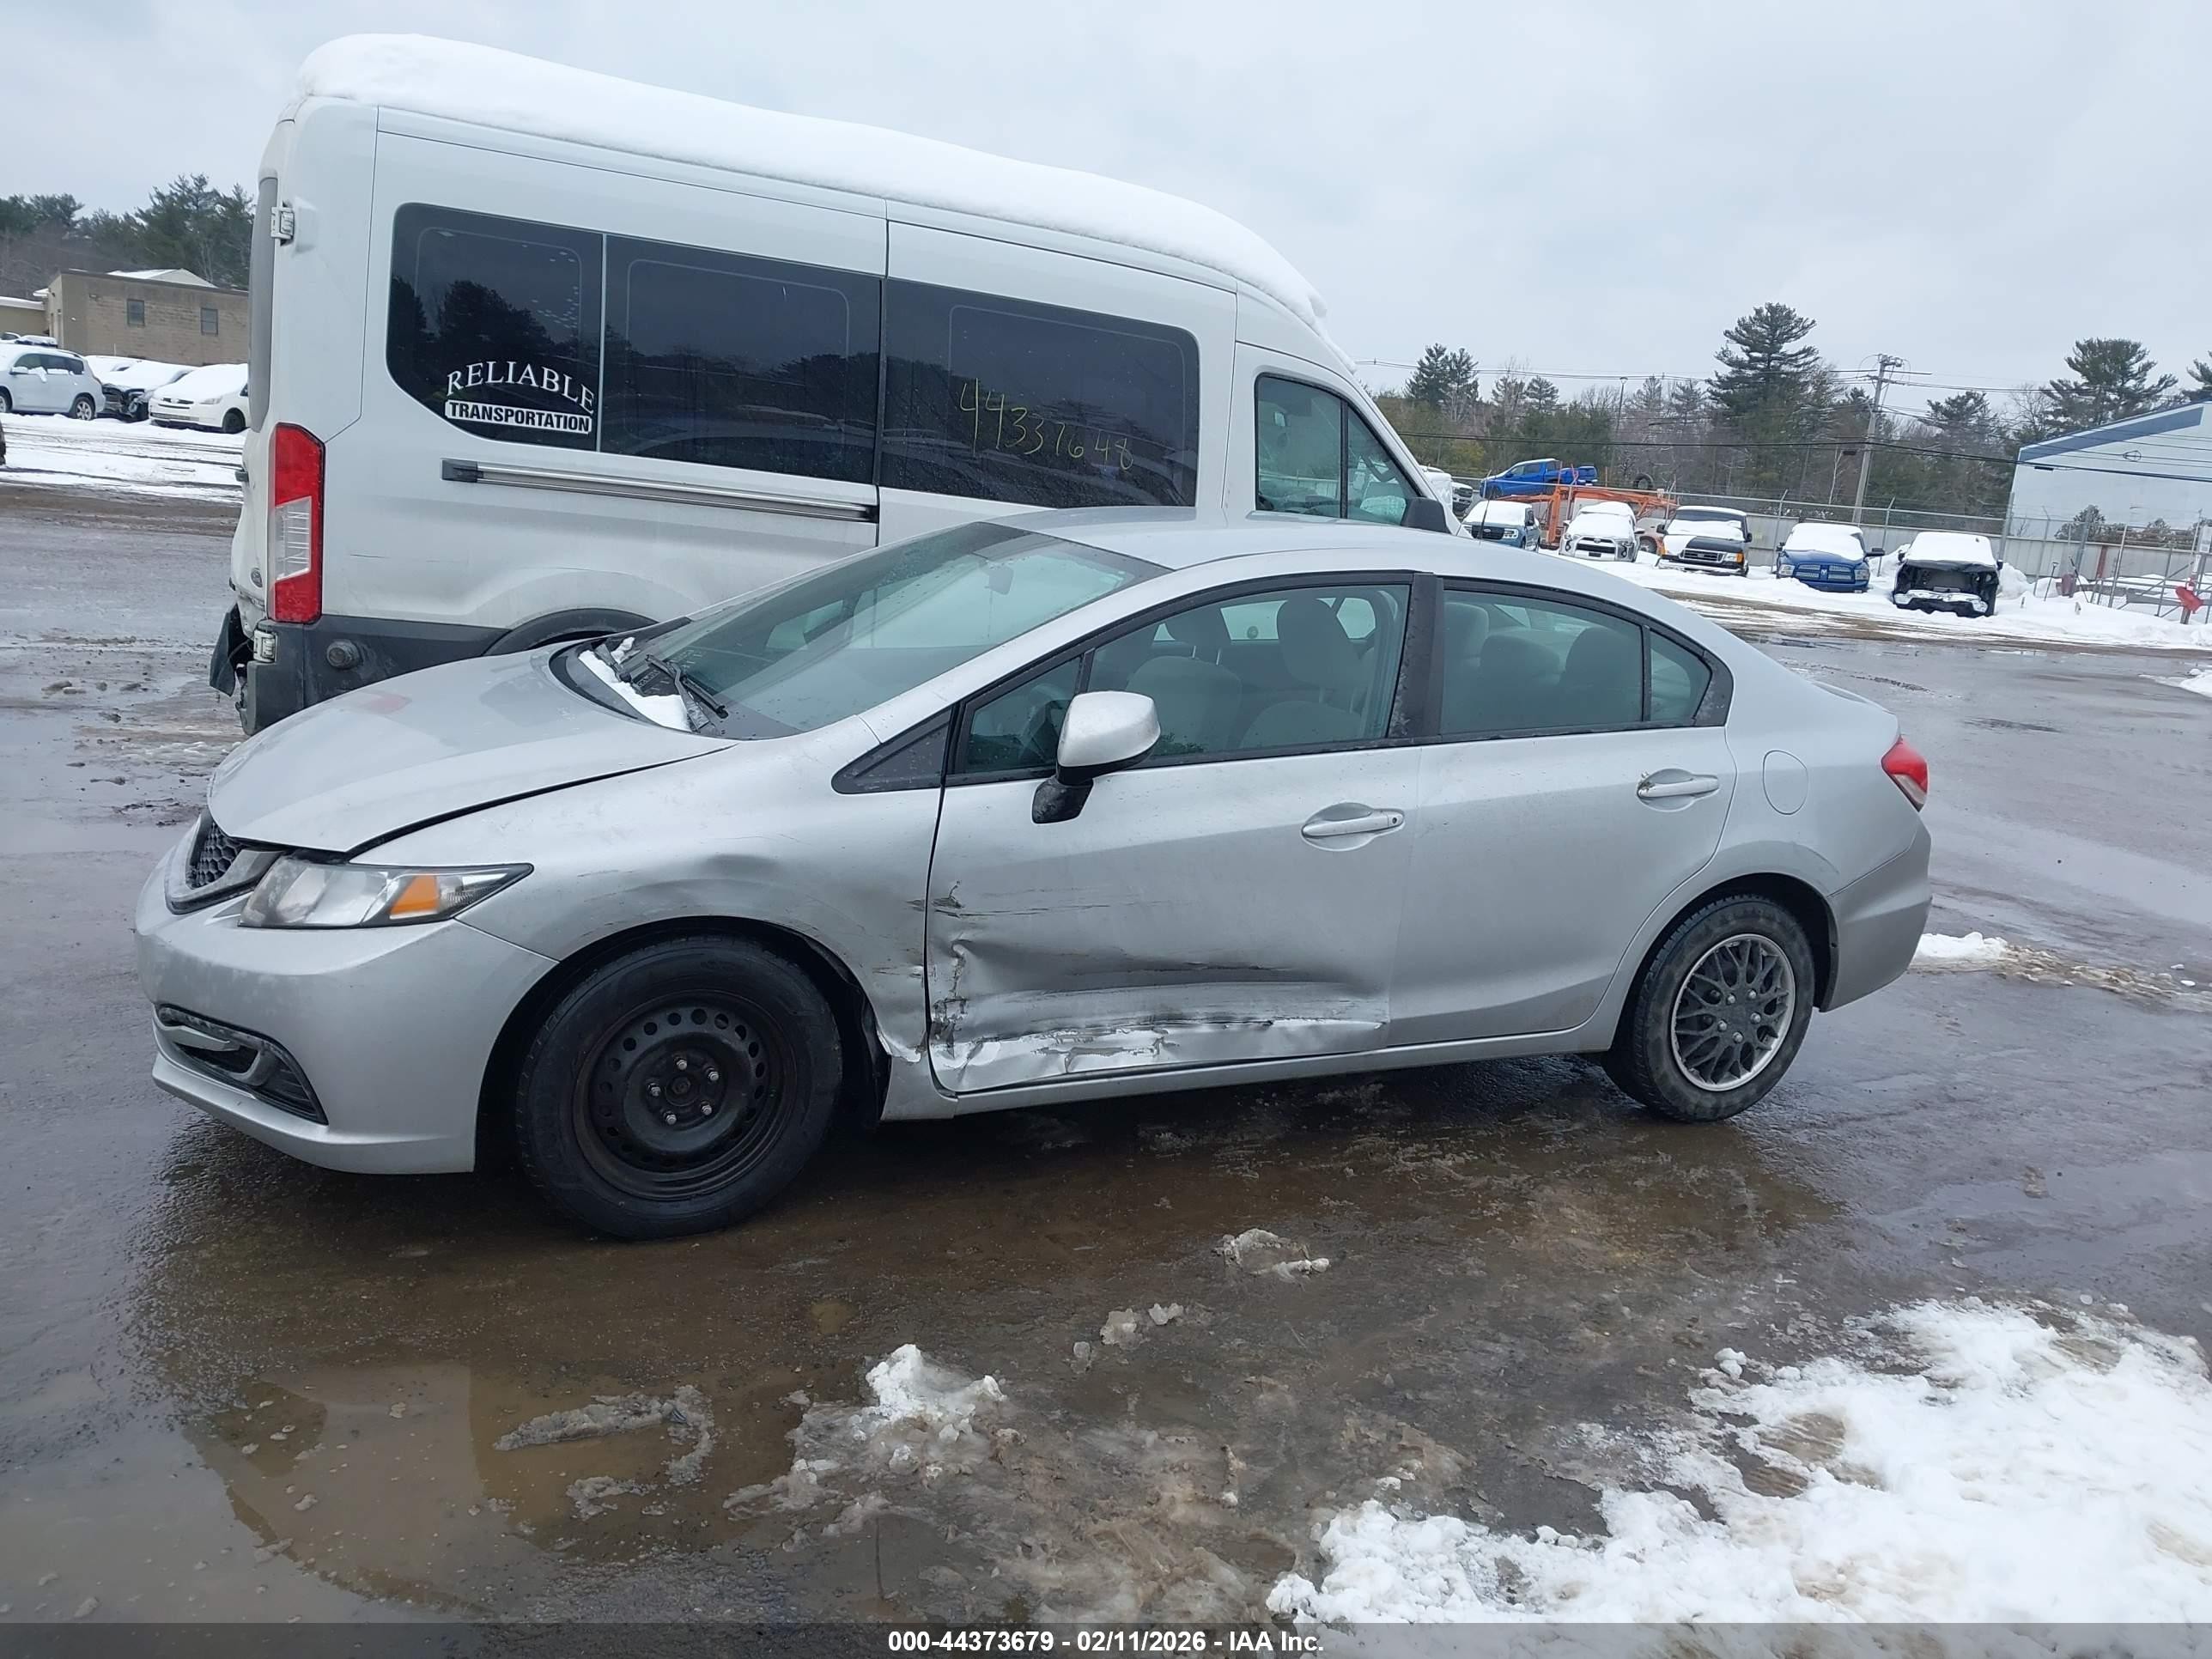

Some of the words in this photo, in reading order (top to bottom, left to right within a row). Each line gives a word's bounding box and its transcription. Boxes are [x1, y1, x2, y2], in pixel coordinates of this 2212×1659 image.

[447, 361, 594, 415] RELIABLE
[449, 401, 590, 432] TRANSPORTATION
[959, 378, 1134, 471] 44337648
